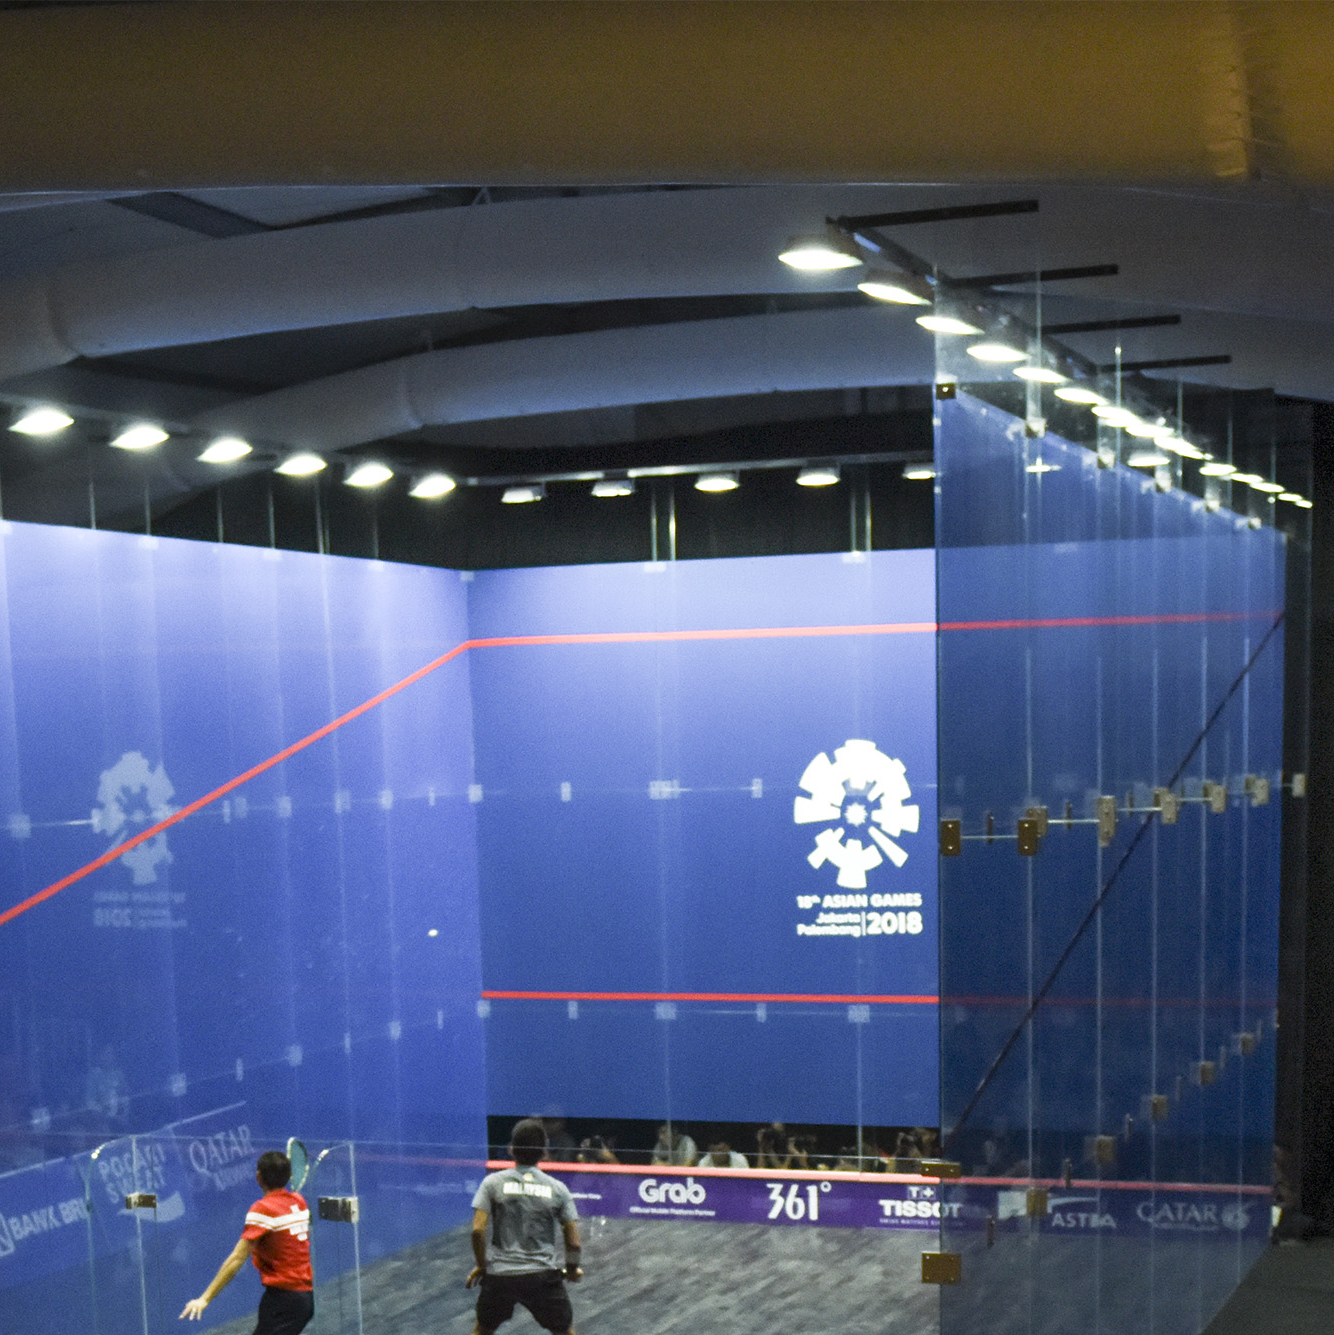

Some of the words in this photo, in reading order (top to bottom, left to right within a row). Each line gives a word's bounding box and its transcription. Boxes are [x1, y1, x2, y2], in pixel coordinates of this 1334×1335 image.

[822, 893, 869, 908] ASIAN
[870, 892, 923, 907] GAMES
[816, 911, 861, 924] Jakarta
[866, 910, 924, 935] 2018
[796, 923, 862, 938] Palembang
[189, 1124, 256, 1177] QATAR
[638, 1177, 706, 1205] Grab
[878, 1199, 963, 1218] TISSOT
[8, 1205, 61, 1242] BANK
